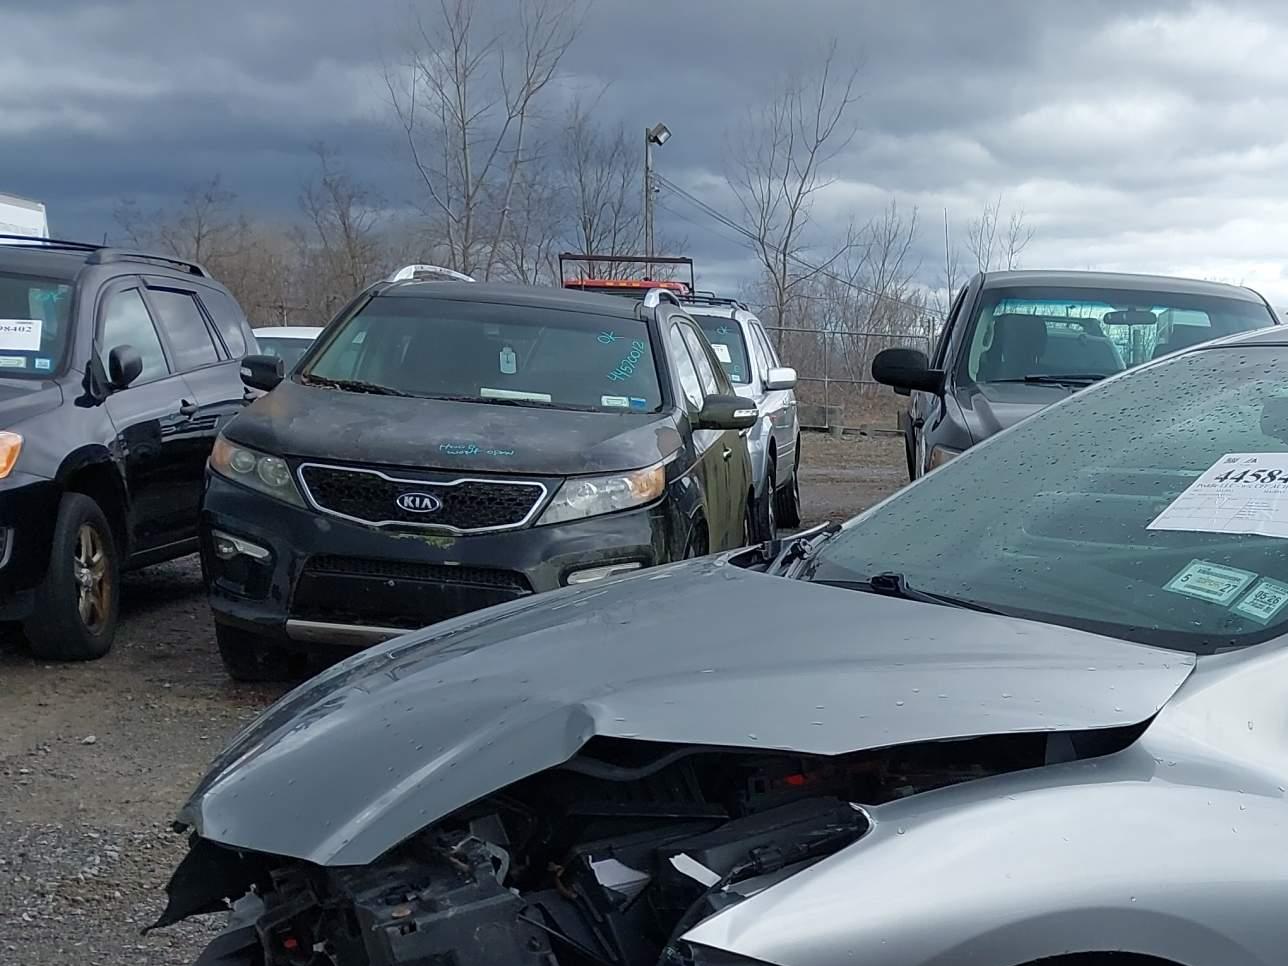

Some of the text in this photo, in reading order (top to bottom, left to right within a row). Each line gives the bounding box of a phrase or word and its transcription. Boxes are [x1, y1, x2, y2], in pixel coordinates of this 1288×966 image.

[403, 496, 432, 508] KIA
[1180, 574, 1192, 583] 5
[1220, 583, 1238, 594] 27
